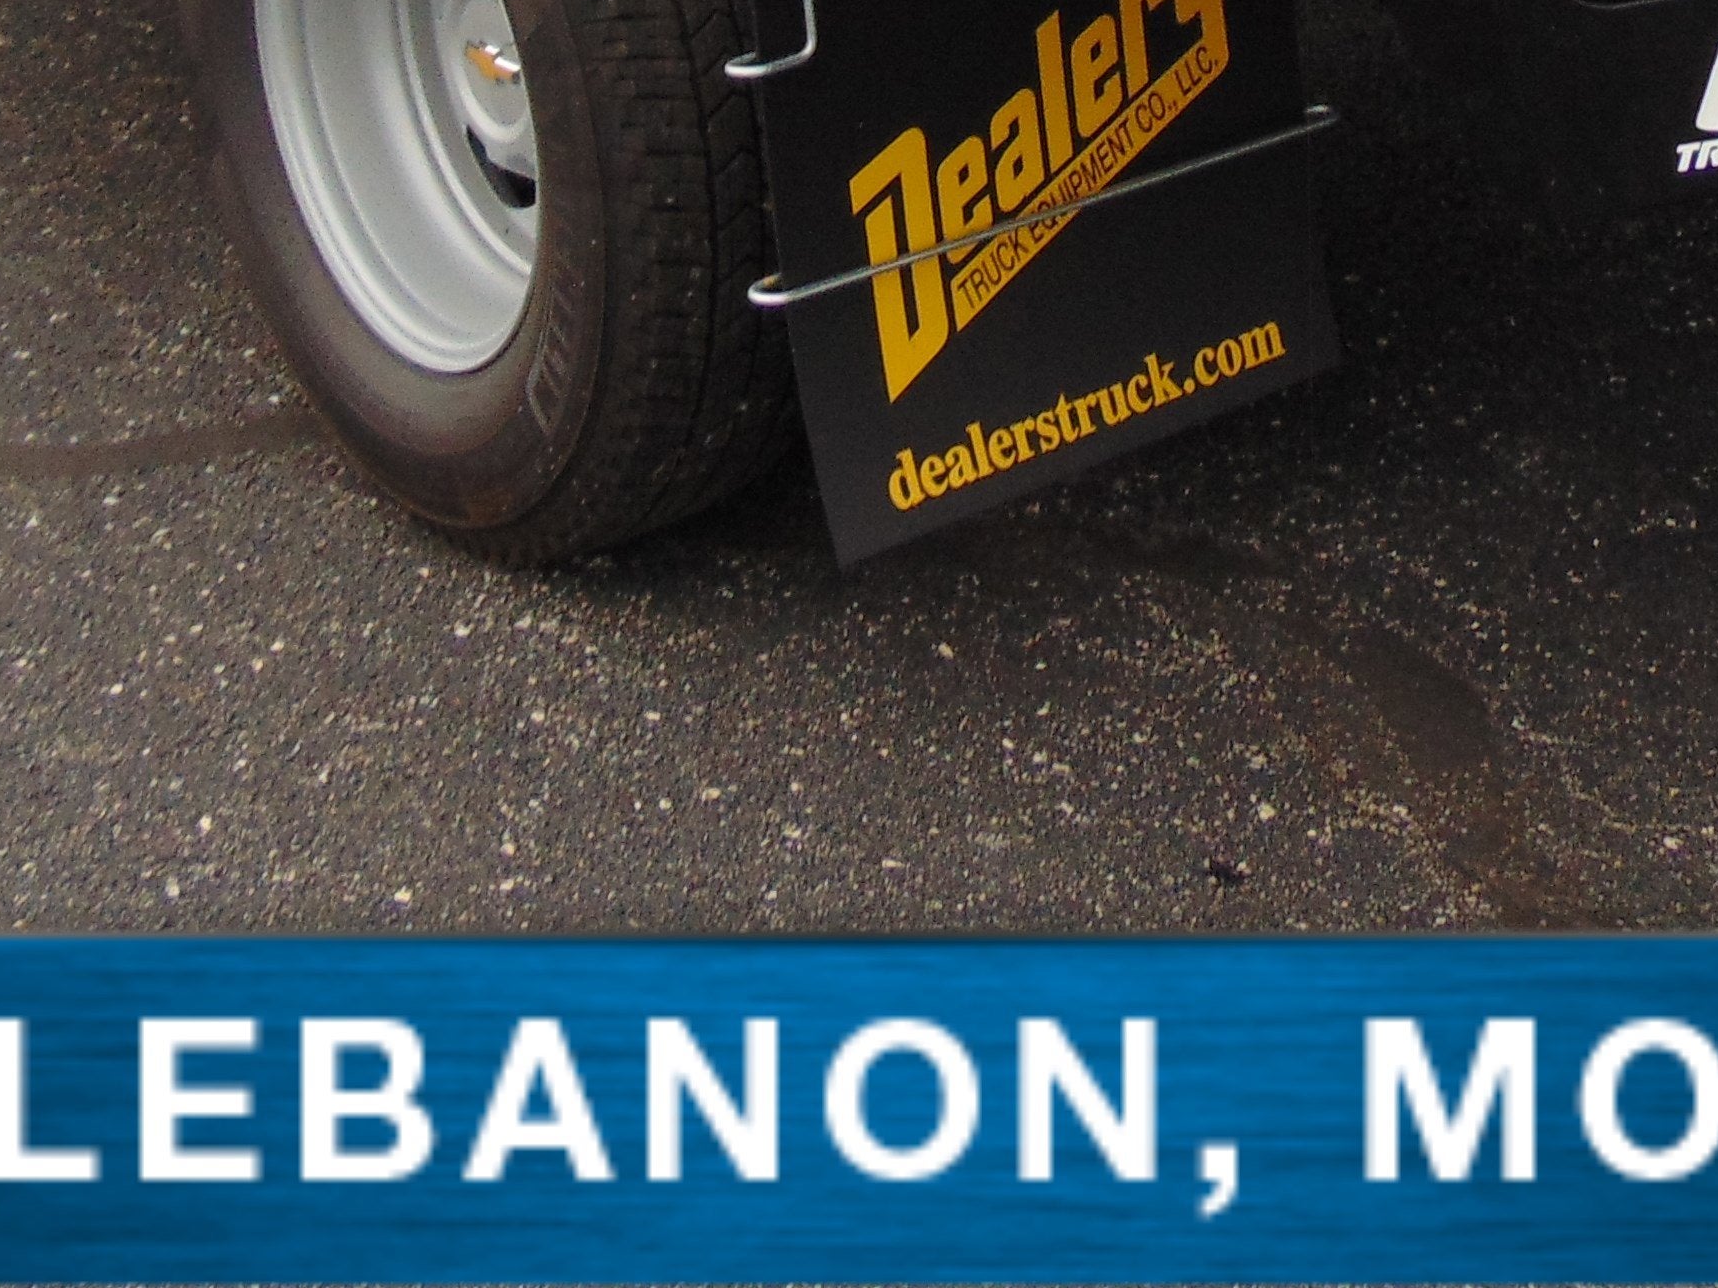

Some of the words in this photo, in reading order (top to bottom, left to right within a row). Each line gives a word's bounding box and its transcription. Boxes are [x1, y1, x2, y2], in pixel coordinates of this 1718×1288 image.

[956, 231, 1031, 310] TRUCK
[1029, 119, 1135, 244] EQUIPMENT
[887, 320, 1286, 512] dealerstruck.com
